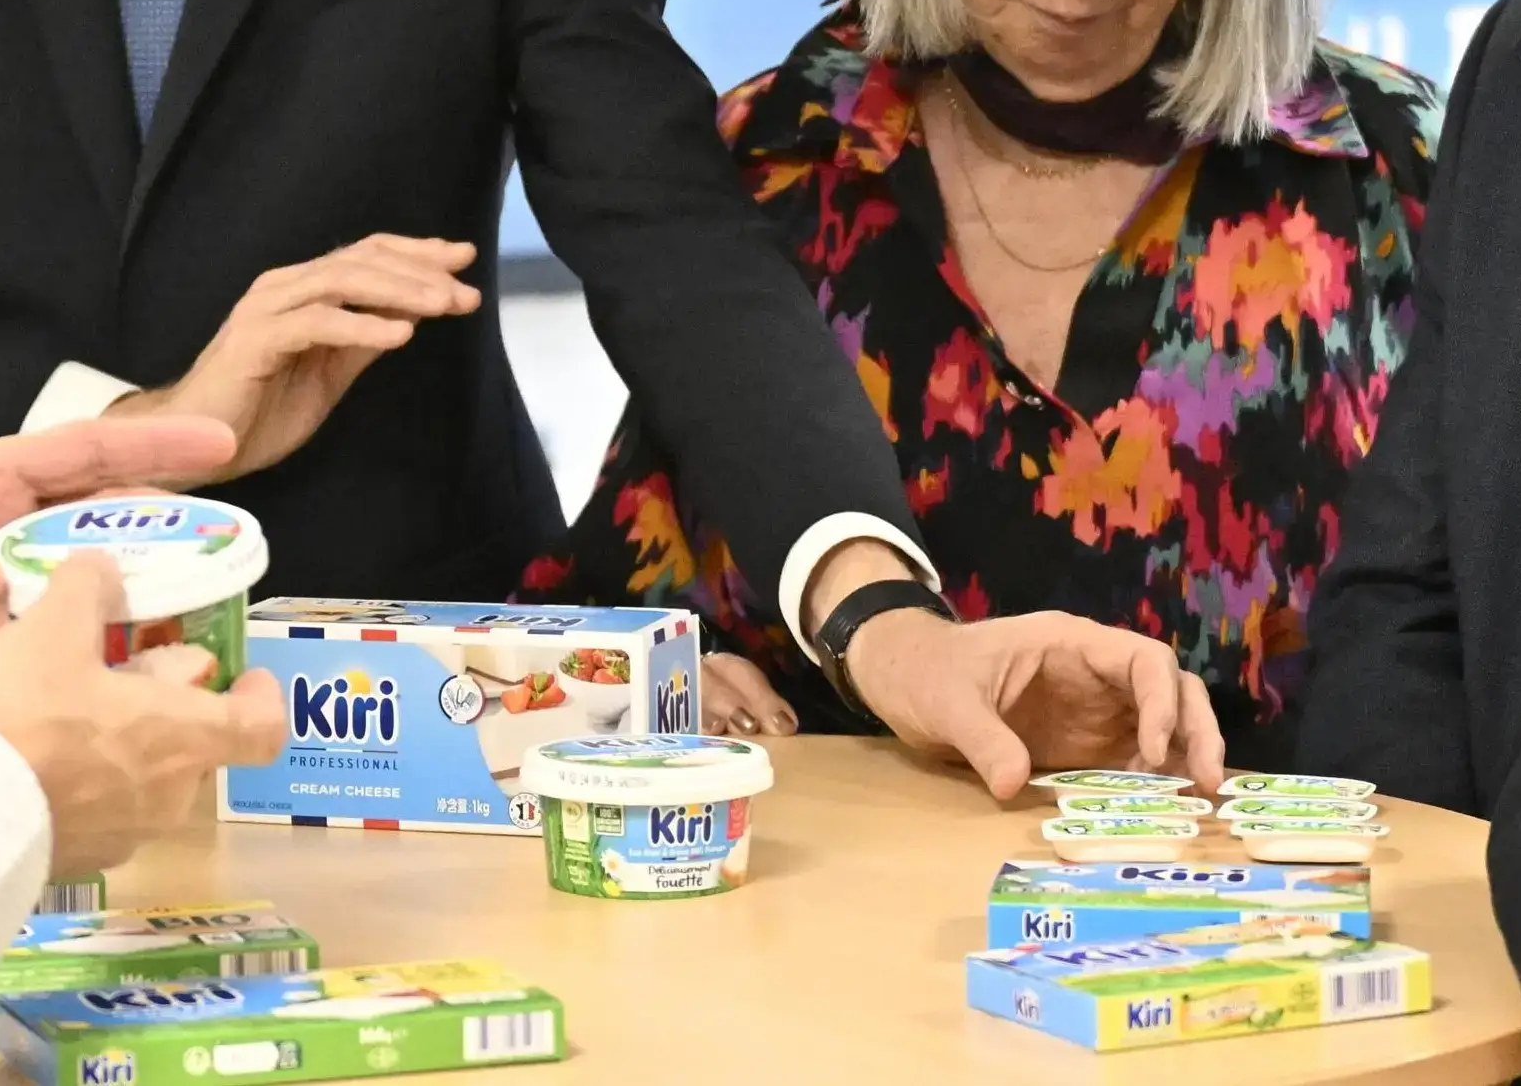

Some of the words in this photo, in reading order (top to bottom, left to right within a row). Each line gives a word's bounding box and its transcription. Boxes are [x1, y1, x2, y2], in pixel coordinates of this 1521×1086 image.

[74, 508, 184, 529] Kiri
[293, 676, 396, 741] Kiri
[657, 673, 690, 734] Kiri
[290, 756, 399, 771] PROFESSIONAL
[289, 783, 340, 796] CREAM
[344, 786, 401, 799] CHEESE
[650, 804, 713, 845] Kiri
[1120, 866, 1246, 883] Kiri
[1024, 912, 1073, 941] Kiri
[82, 984, 237, 1010] Kiri
[1128, 997, 1172, 1030] Kiri
[82, 1055, 132, 1085] Kiri
